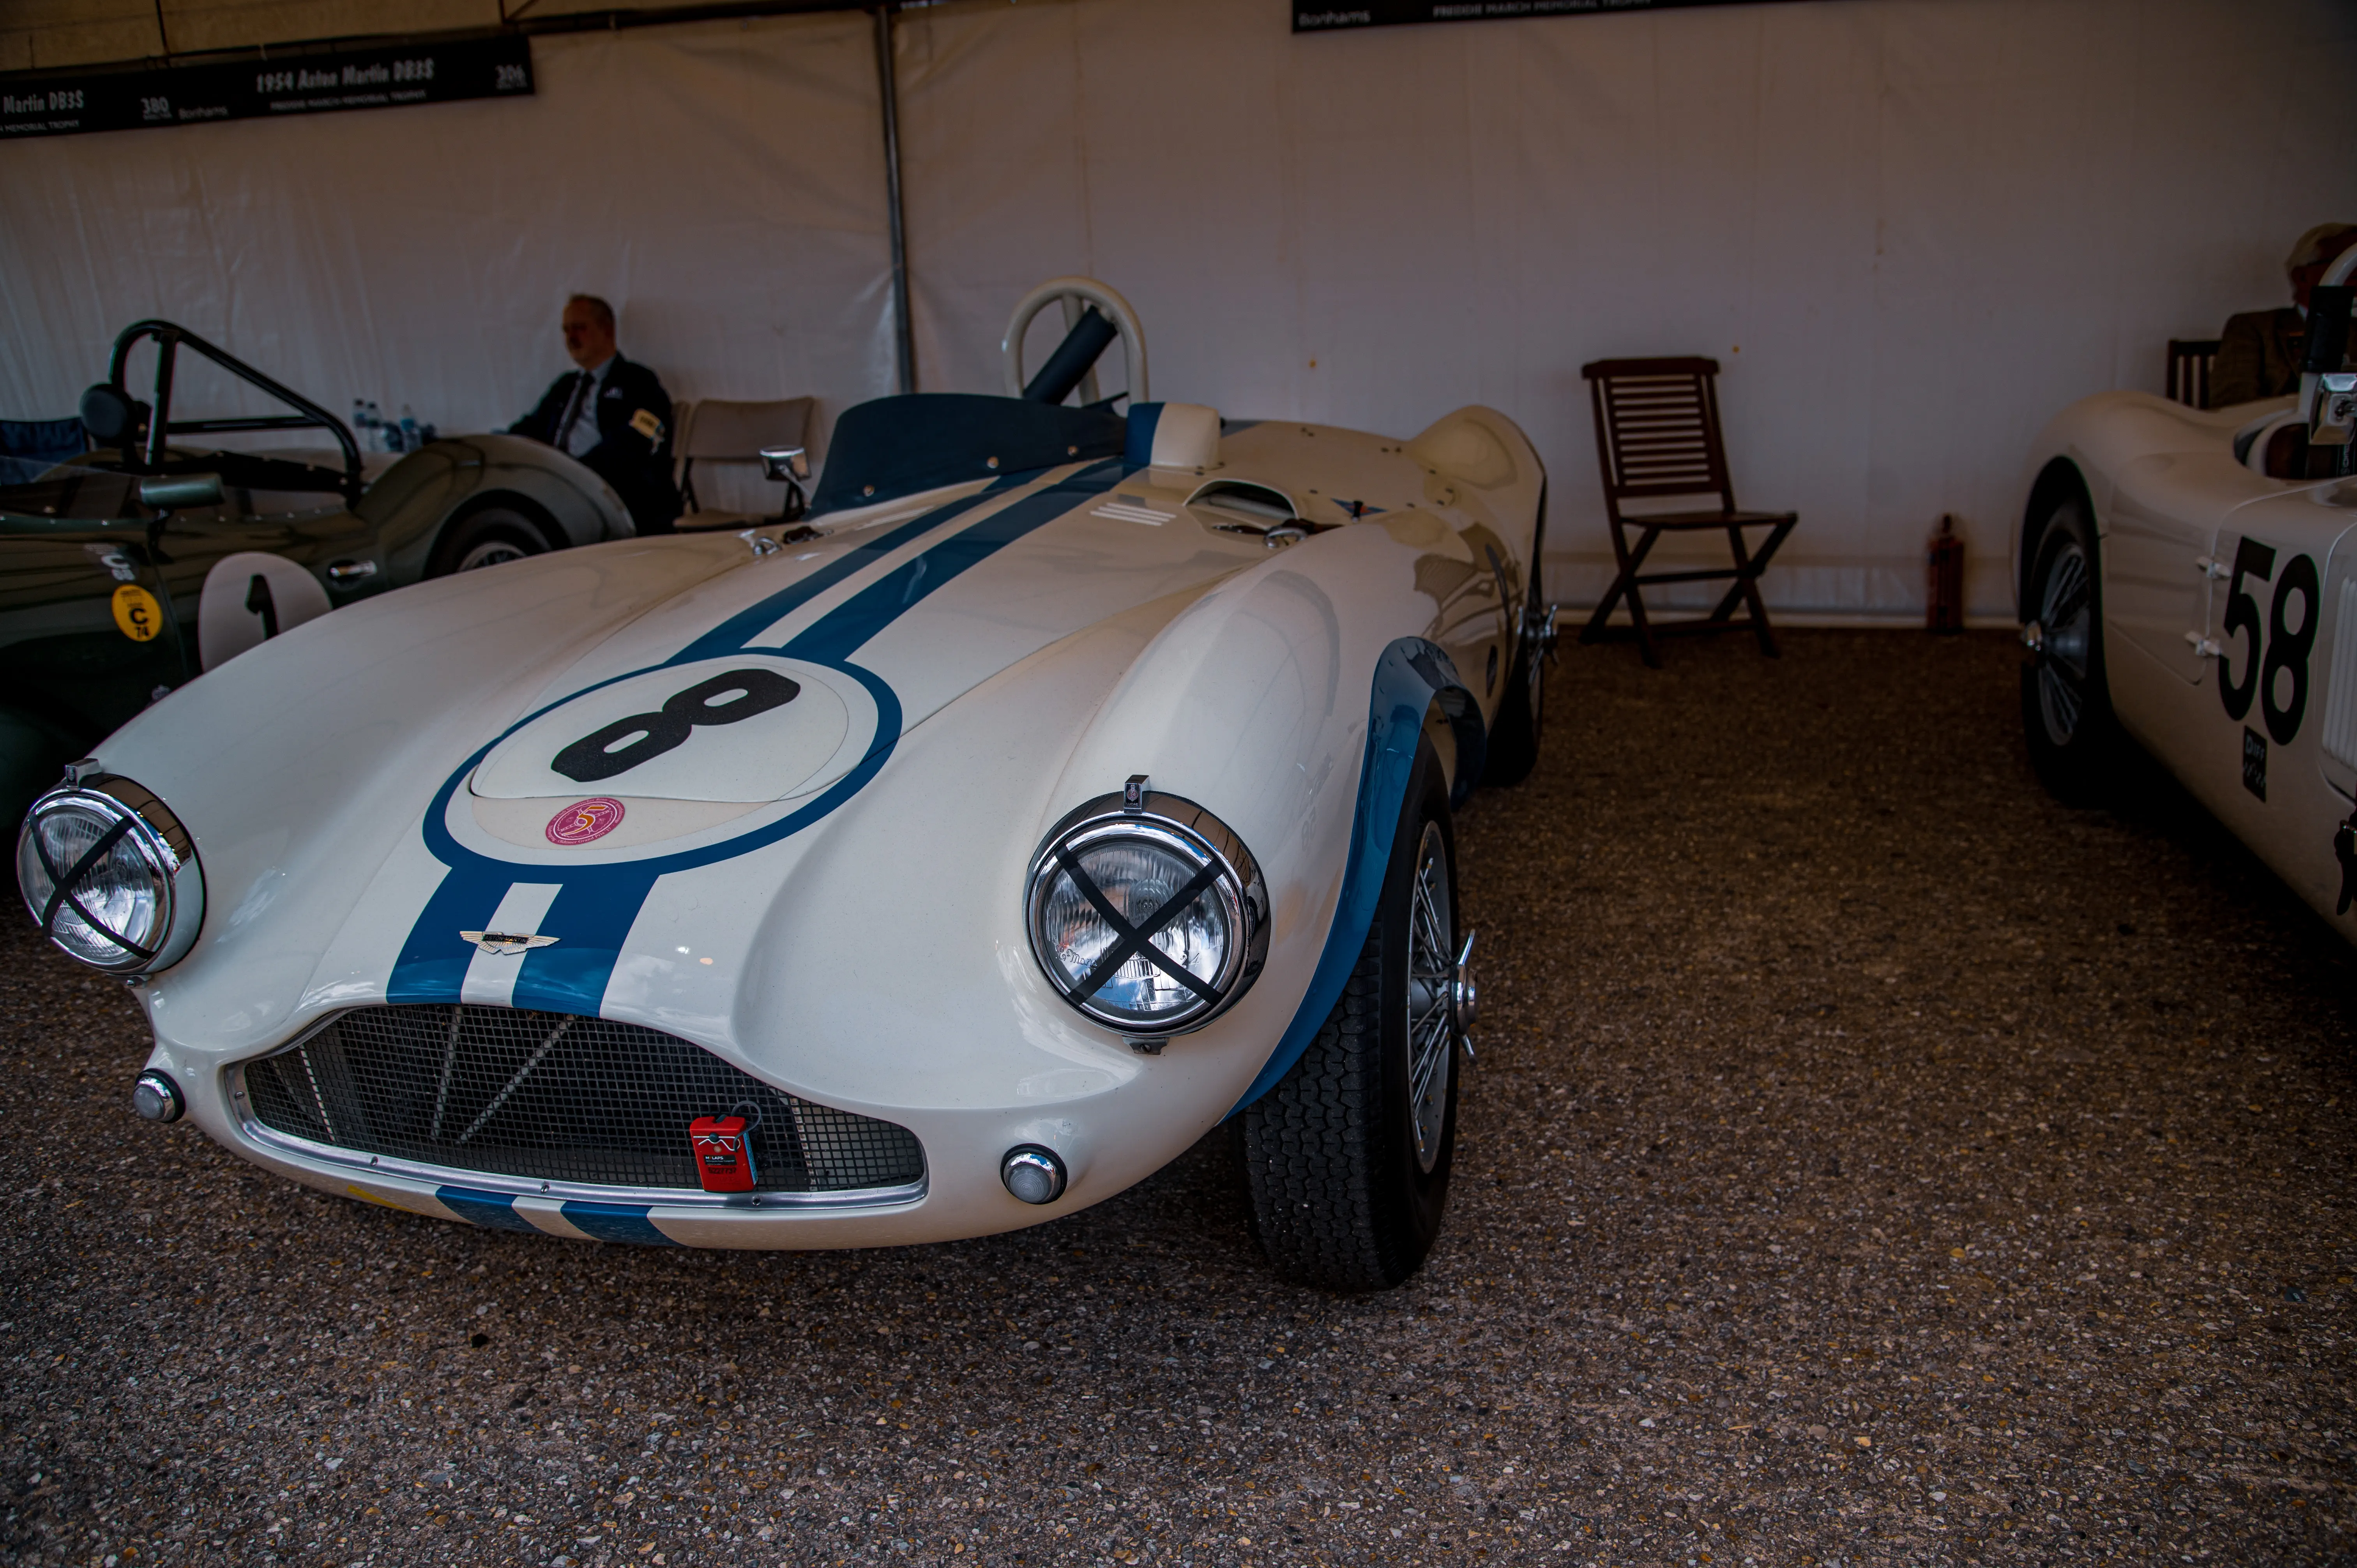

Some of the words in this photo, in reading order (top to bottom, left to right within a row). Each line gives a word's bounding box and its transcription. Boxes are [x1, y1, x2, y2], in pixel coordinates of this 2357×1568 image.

[1298, 10, 1371, 27] Bonhams
[256, 71, 295, 94] 1954
[297, 68, 338, 91] Aston
[342, 62, 389, 87] Martin
[393, 57, 435, 82] DB3S
[3, 94, 46, 114] Martin
[48, 89, 84, 111] DB3S
[101, 555, 130, 568] C
[129, 608, 149, 624] C
[245, 573, 279, 640] 1
[2218, 535, 2320, 746] 58
[551, 669, 800, 782] 8
[561, 805, 608, 836] 5
